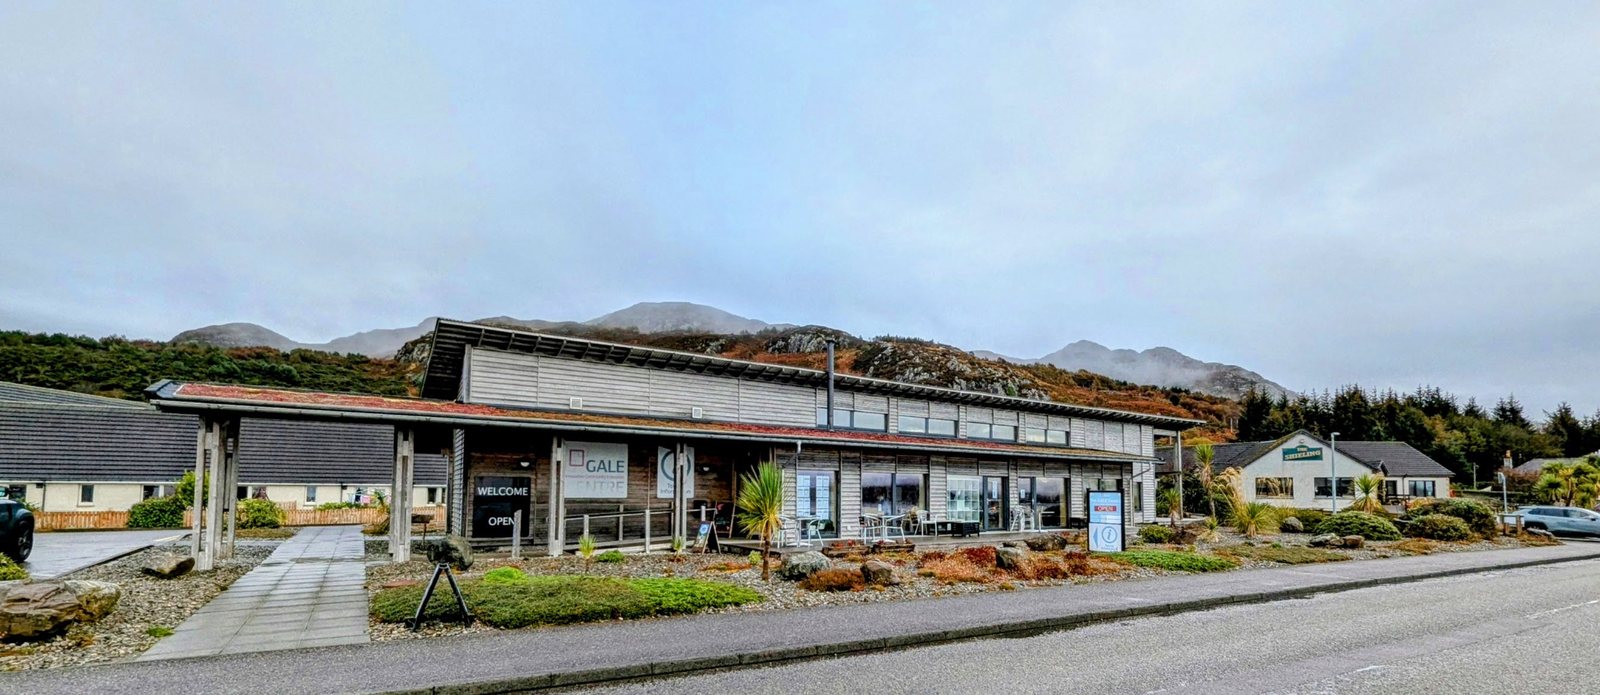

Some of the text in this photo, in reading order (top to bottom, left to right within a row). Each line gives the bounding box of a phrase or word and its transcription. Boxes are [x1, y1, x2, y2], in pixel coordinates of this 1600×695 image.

[1284, 449, 1321, 460] SHIELING
[586, 459, 625, 473] GALE
[477, 487, 529, 496] WELCOME
[571, 480, 625, 493] ENTRE
